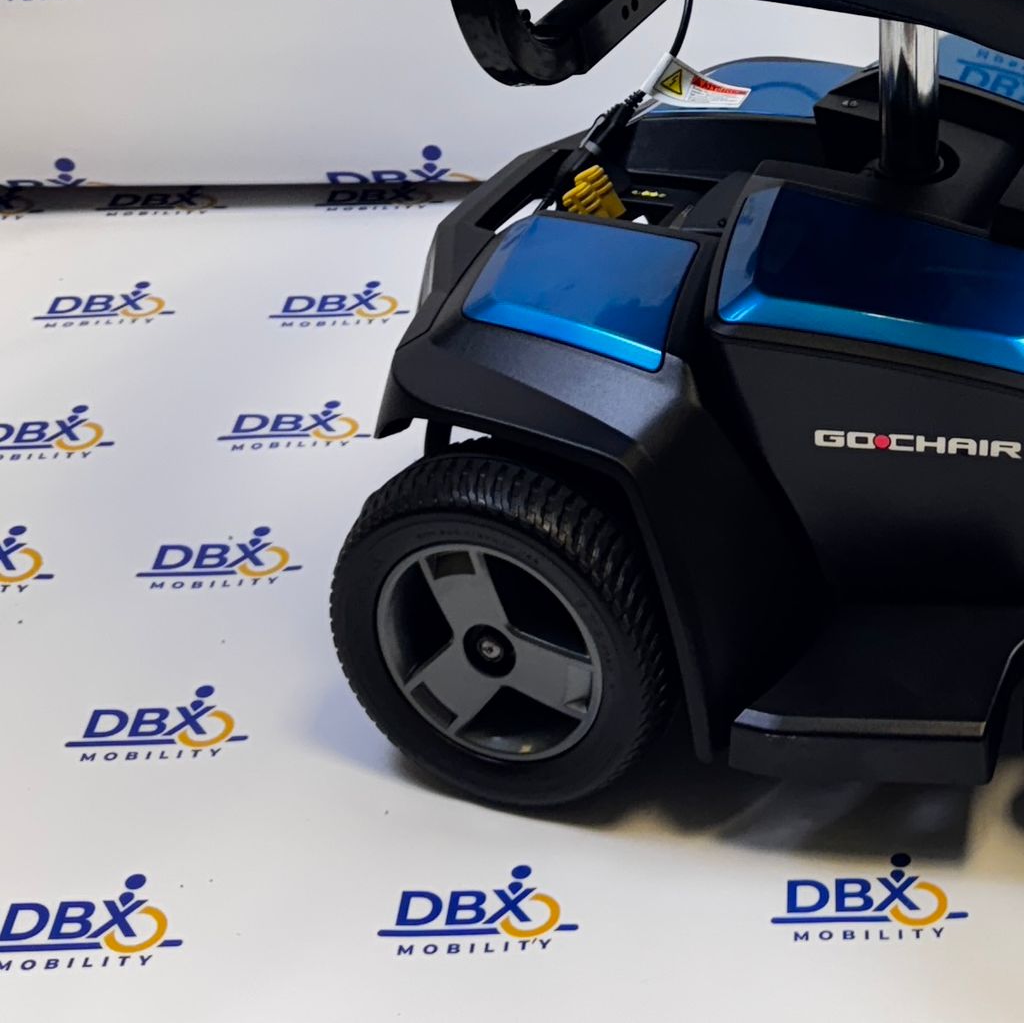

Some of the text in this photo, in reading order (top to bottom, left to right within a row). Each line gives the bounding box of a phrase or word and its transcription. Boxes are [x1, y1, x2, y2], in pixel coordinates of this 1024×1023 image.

[46, 291, 150, 315] DBX
[281, 291, 382, 313] DBX
[45, 319, 152, 328] MOBILITY
[281, 319, 388, 327] MOBILITY
[232, 414, 341, 433] DBX
[231, 441, 348, 451] MOBILITY
[0, 451, 91, 461] BILITY
[152, 543, 271, 570] DBX
[150, 577, 277, 589] MOBILITY
[83, 706, 215, 738] DBX
[80, 748, 221, 761] MOBILITY
[787, 876, 920, 913] DBX
[395, 888, 536, 926] DBX
[0, 900, 148, 941] DBX
[794, 928, 943, 941] MOBILITY
[397, 939, 550, 955] MOBILITY
[0, 955, 152, 971] MOBILITY
